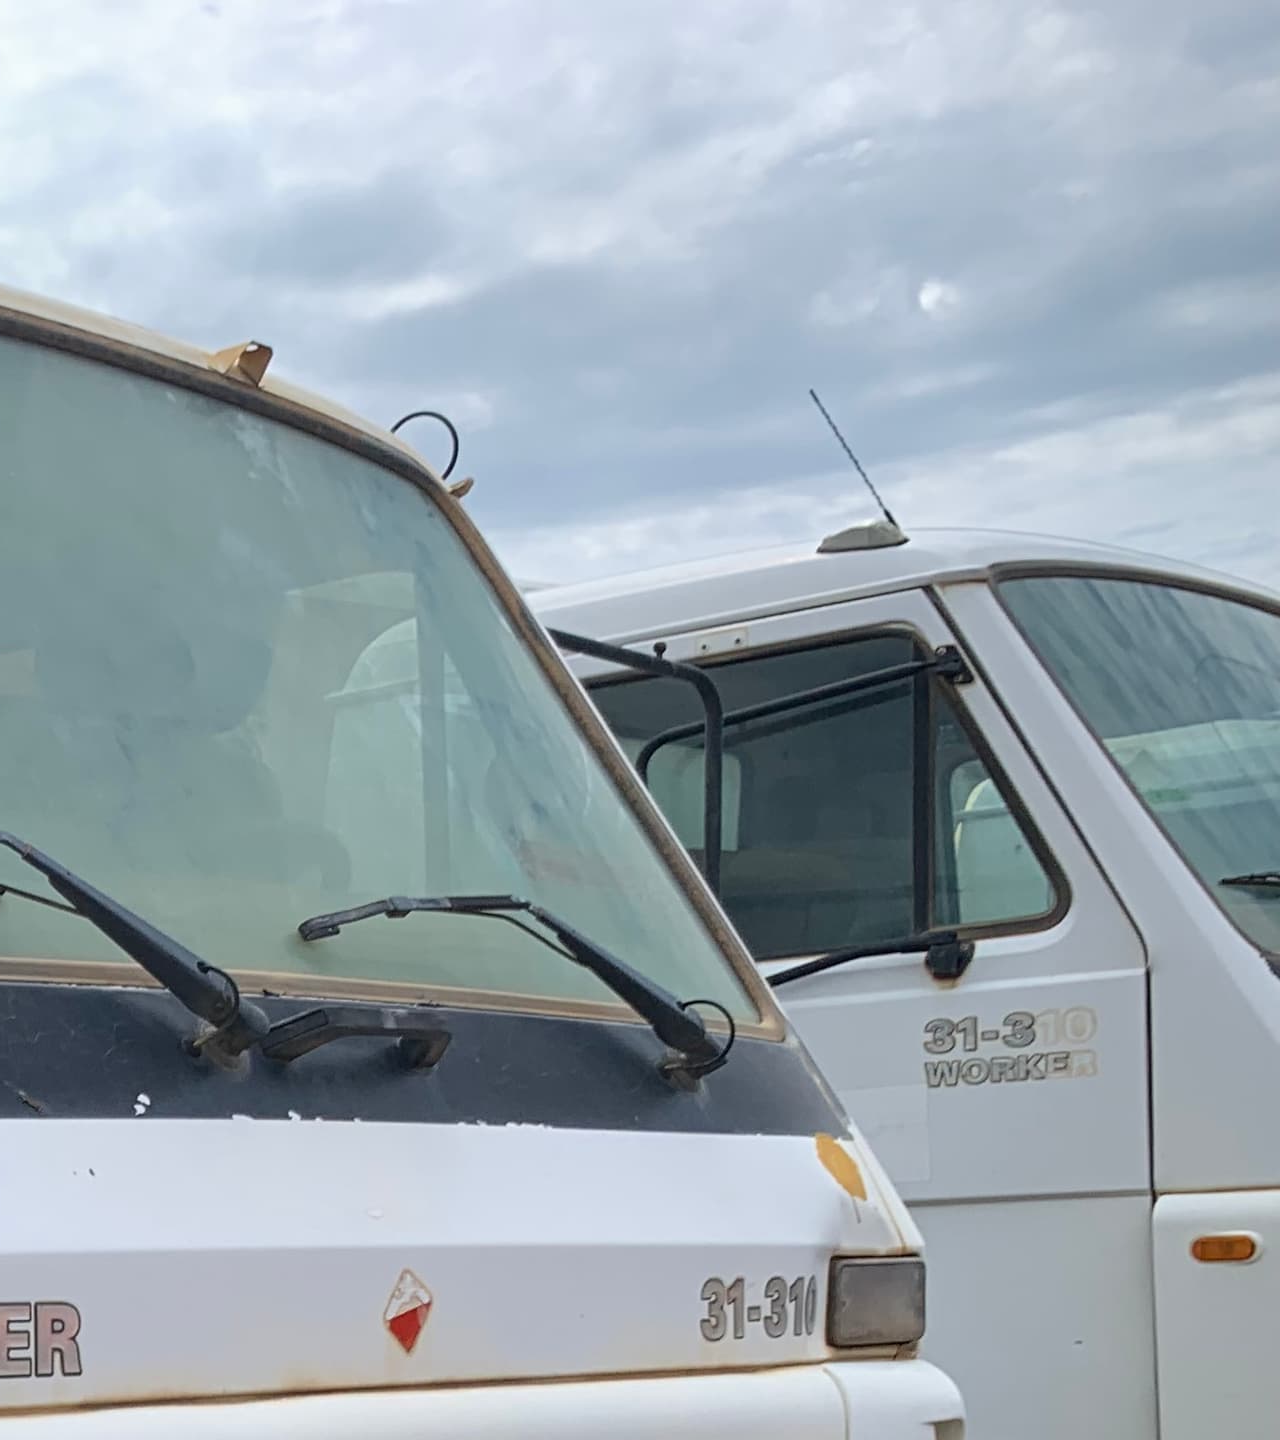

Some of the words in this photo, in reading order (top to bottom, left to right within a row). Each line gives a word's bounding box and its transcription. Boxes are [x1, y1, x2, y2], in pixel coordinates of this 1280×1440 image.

[923, 1006, 1098, 1055] 31-310
[924, 1049, 1098, 1088] WORKER
[699, 1274, 817, 1342] 31-310
